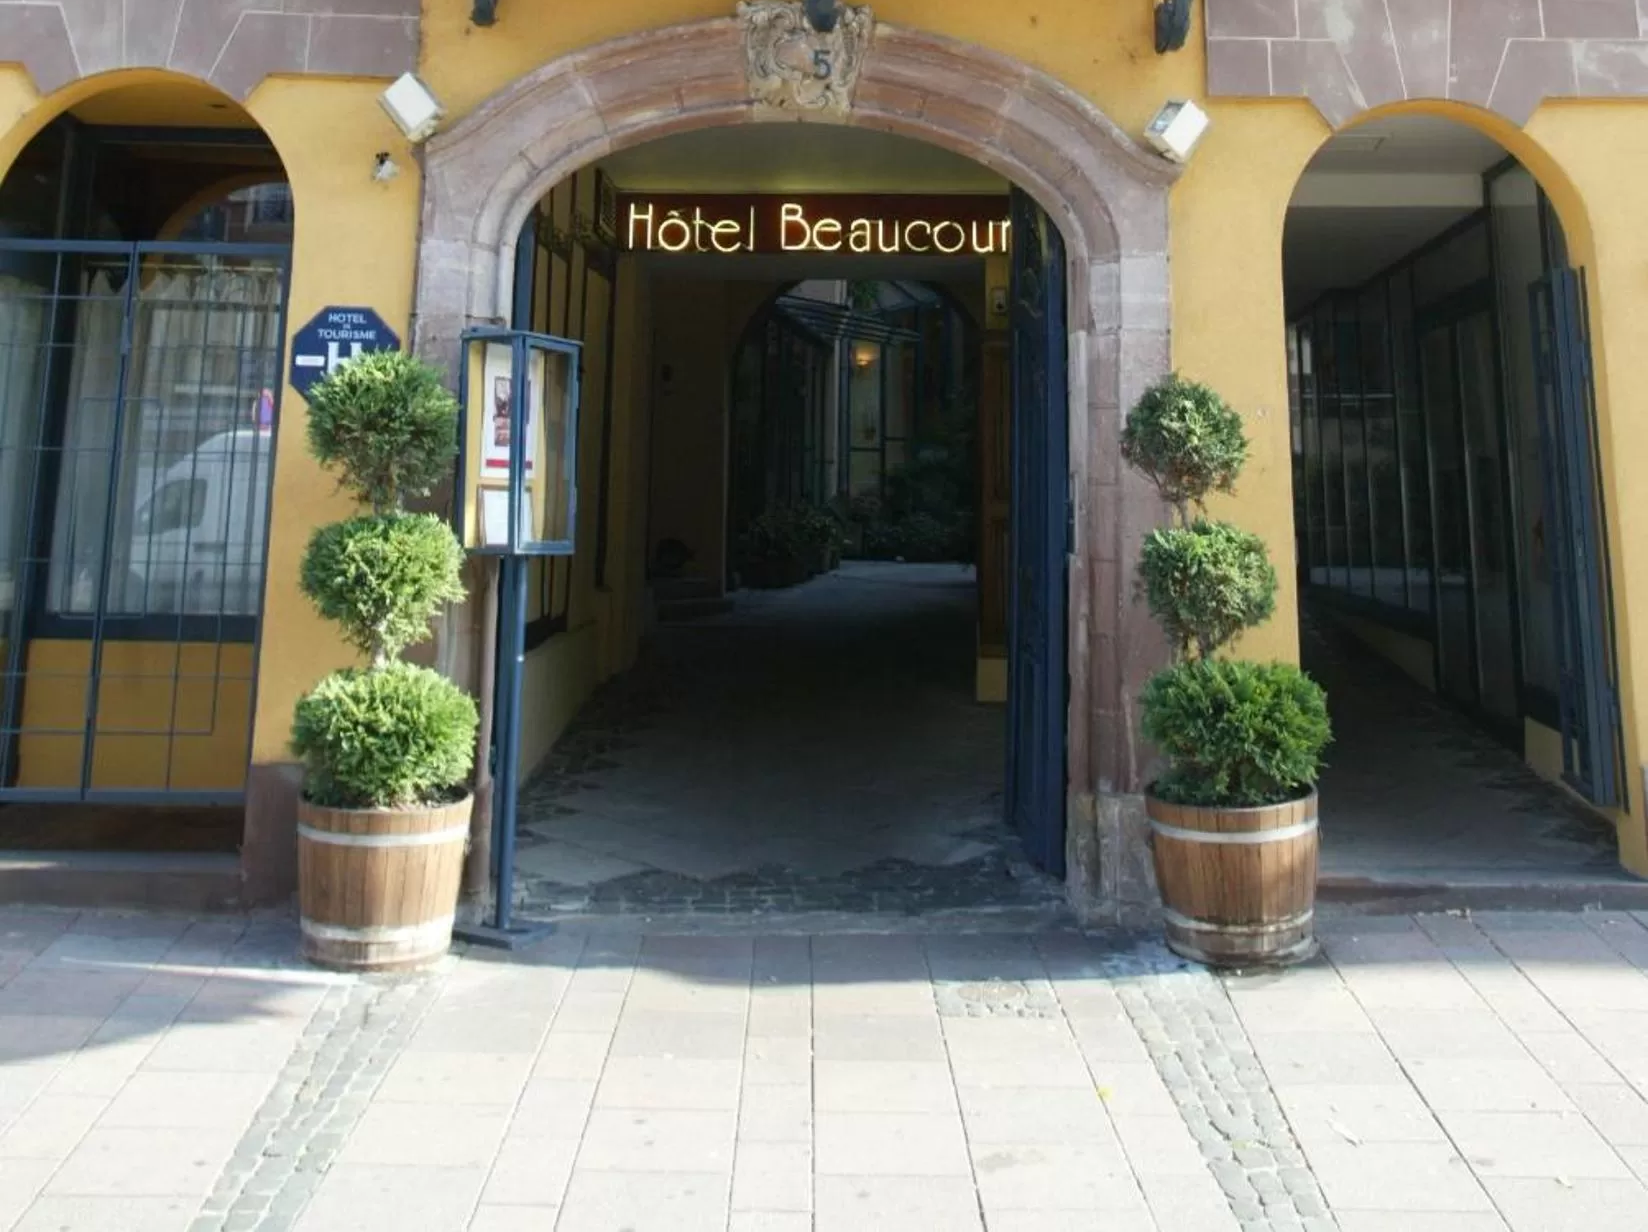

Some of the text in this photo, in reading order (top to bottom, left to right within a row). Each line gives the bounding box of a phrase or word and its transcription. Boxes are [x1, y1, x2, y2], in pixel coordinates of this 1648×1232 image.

[813, 49, 831, 79] 5
[627, 202, 1012, 253] Hôtel Beaucour
[328, 313, 367, 324] HOTEL
[317, 329, 377, 339] TOURISME
